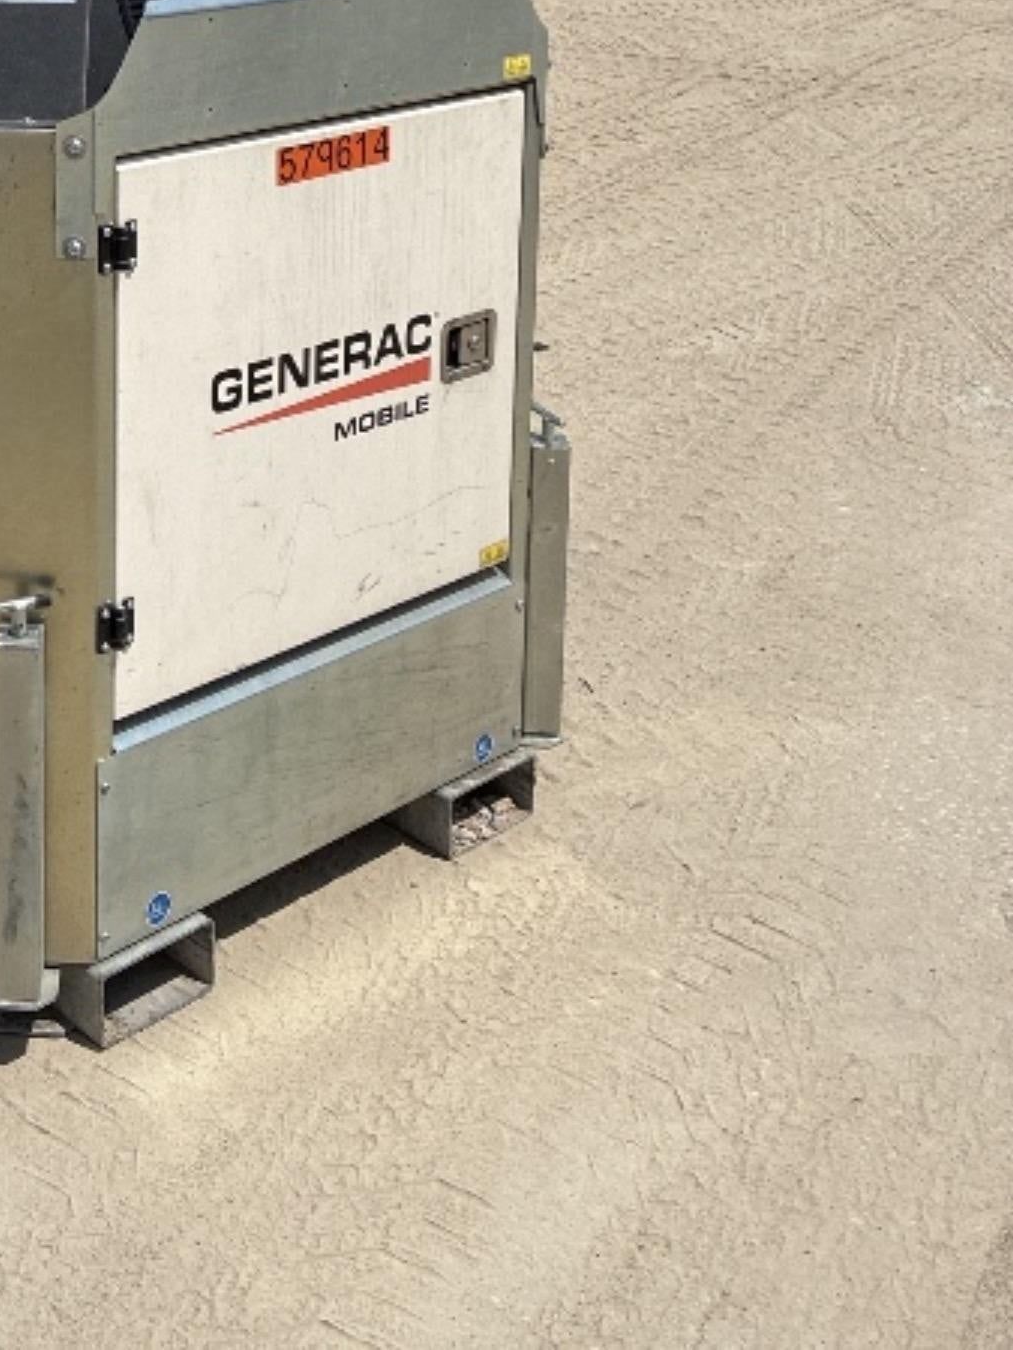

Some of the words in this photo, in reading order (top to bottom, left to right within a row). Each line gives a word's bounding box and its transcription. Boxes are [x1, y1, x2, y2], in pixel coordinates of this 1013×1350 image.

[278, 126, 390, 184] 579614
[211, 313, 432, 414] GENERAC
[334, 393, 430, 442] MOBILE
